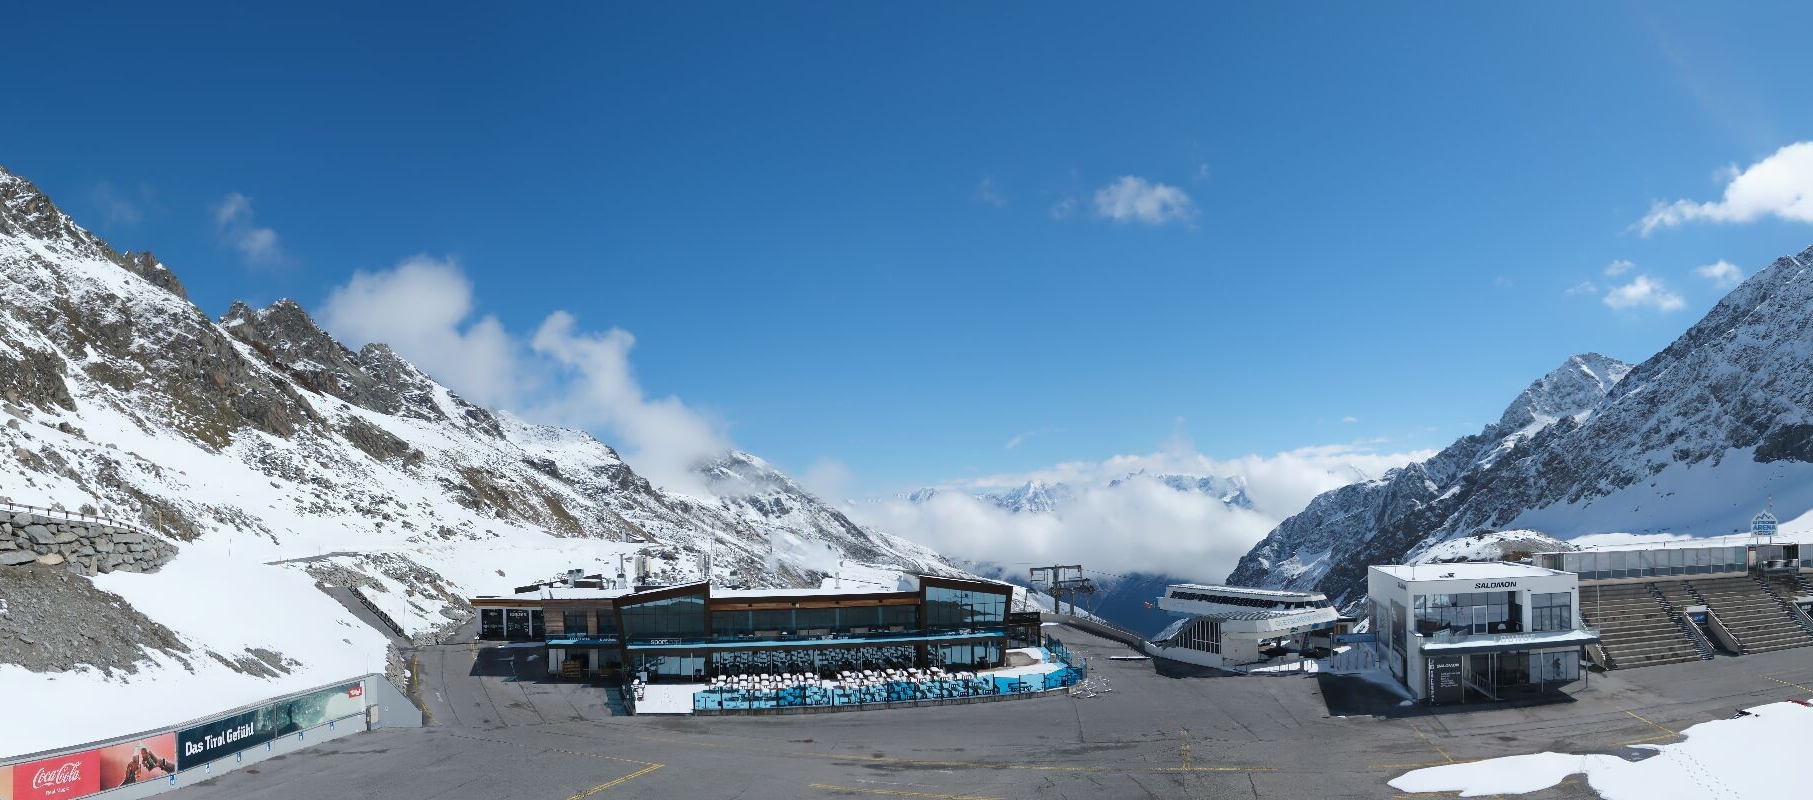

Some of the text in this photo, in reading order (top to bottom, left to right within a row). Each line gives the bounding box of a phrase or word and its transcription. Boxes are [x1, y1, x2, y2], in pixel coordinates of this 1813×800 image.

[1474, 581, 1517, 589] SALOMON
[185, 721, 255, 757] Das Tirol Gefühl
